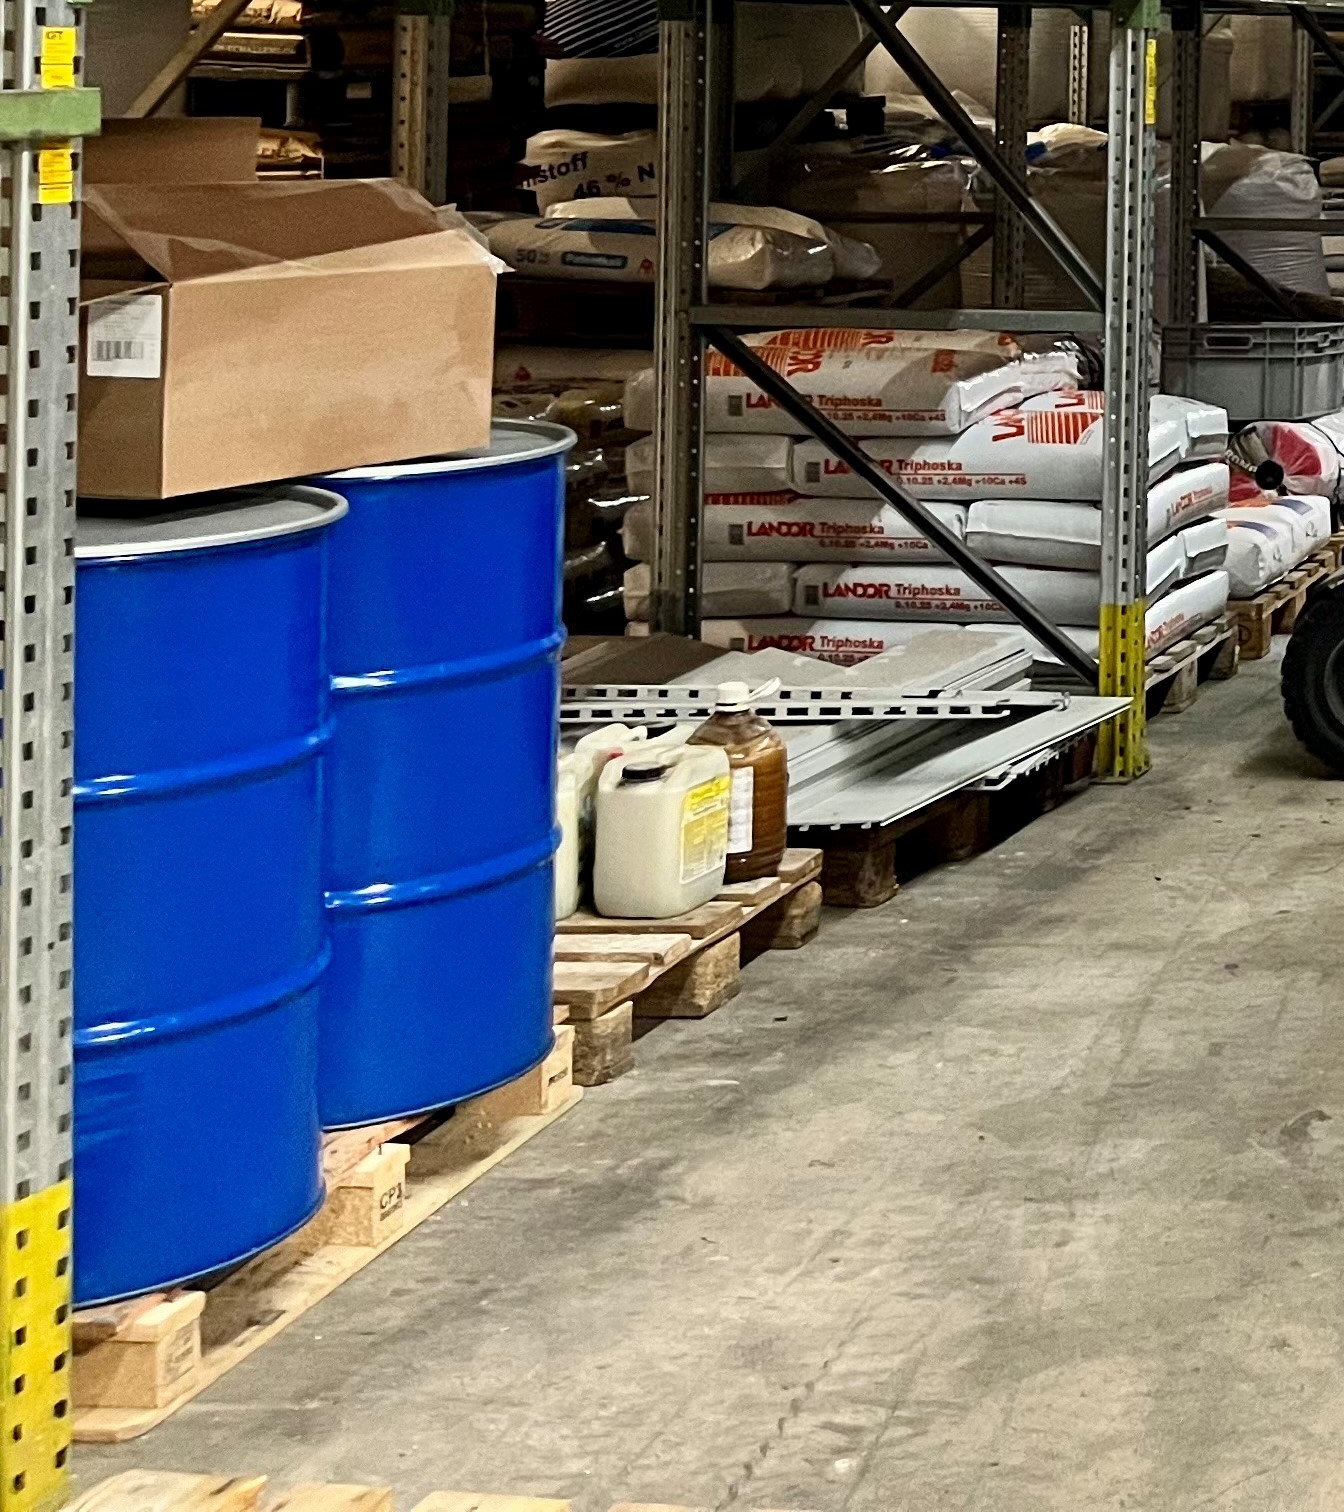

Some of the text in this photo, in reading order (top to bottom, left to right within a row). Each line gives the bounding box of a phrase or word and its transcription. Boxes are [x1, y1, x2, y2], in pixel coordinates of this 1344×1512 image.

[574, 179, 600, 200] 46
[637, 162, 655, 183] N
[818, 394, 882, 409] Triphoska
[896, 459, 963, 473] Triphoska
[747, 520, 884, 538] LANDOR Triphoska
[822, 581, 961, 599] LANDOR Triphoska
[819, 635, 884, 650] Triphoska
